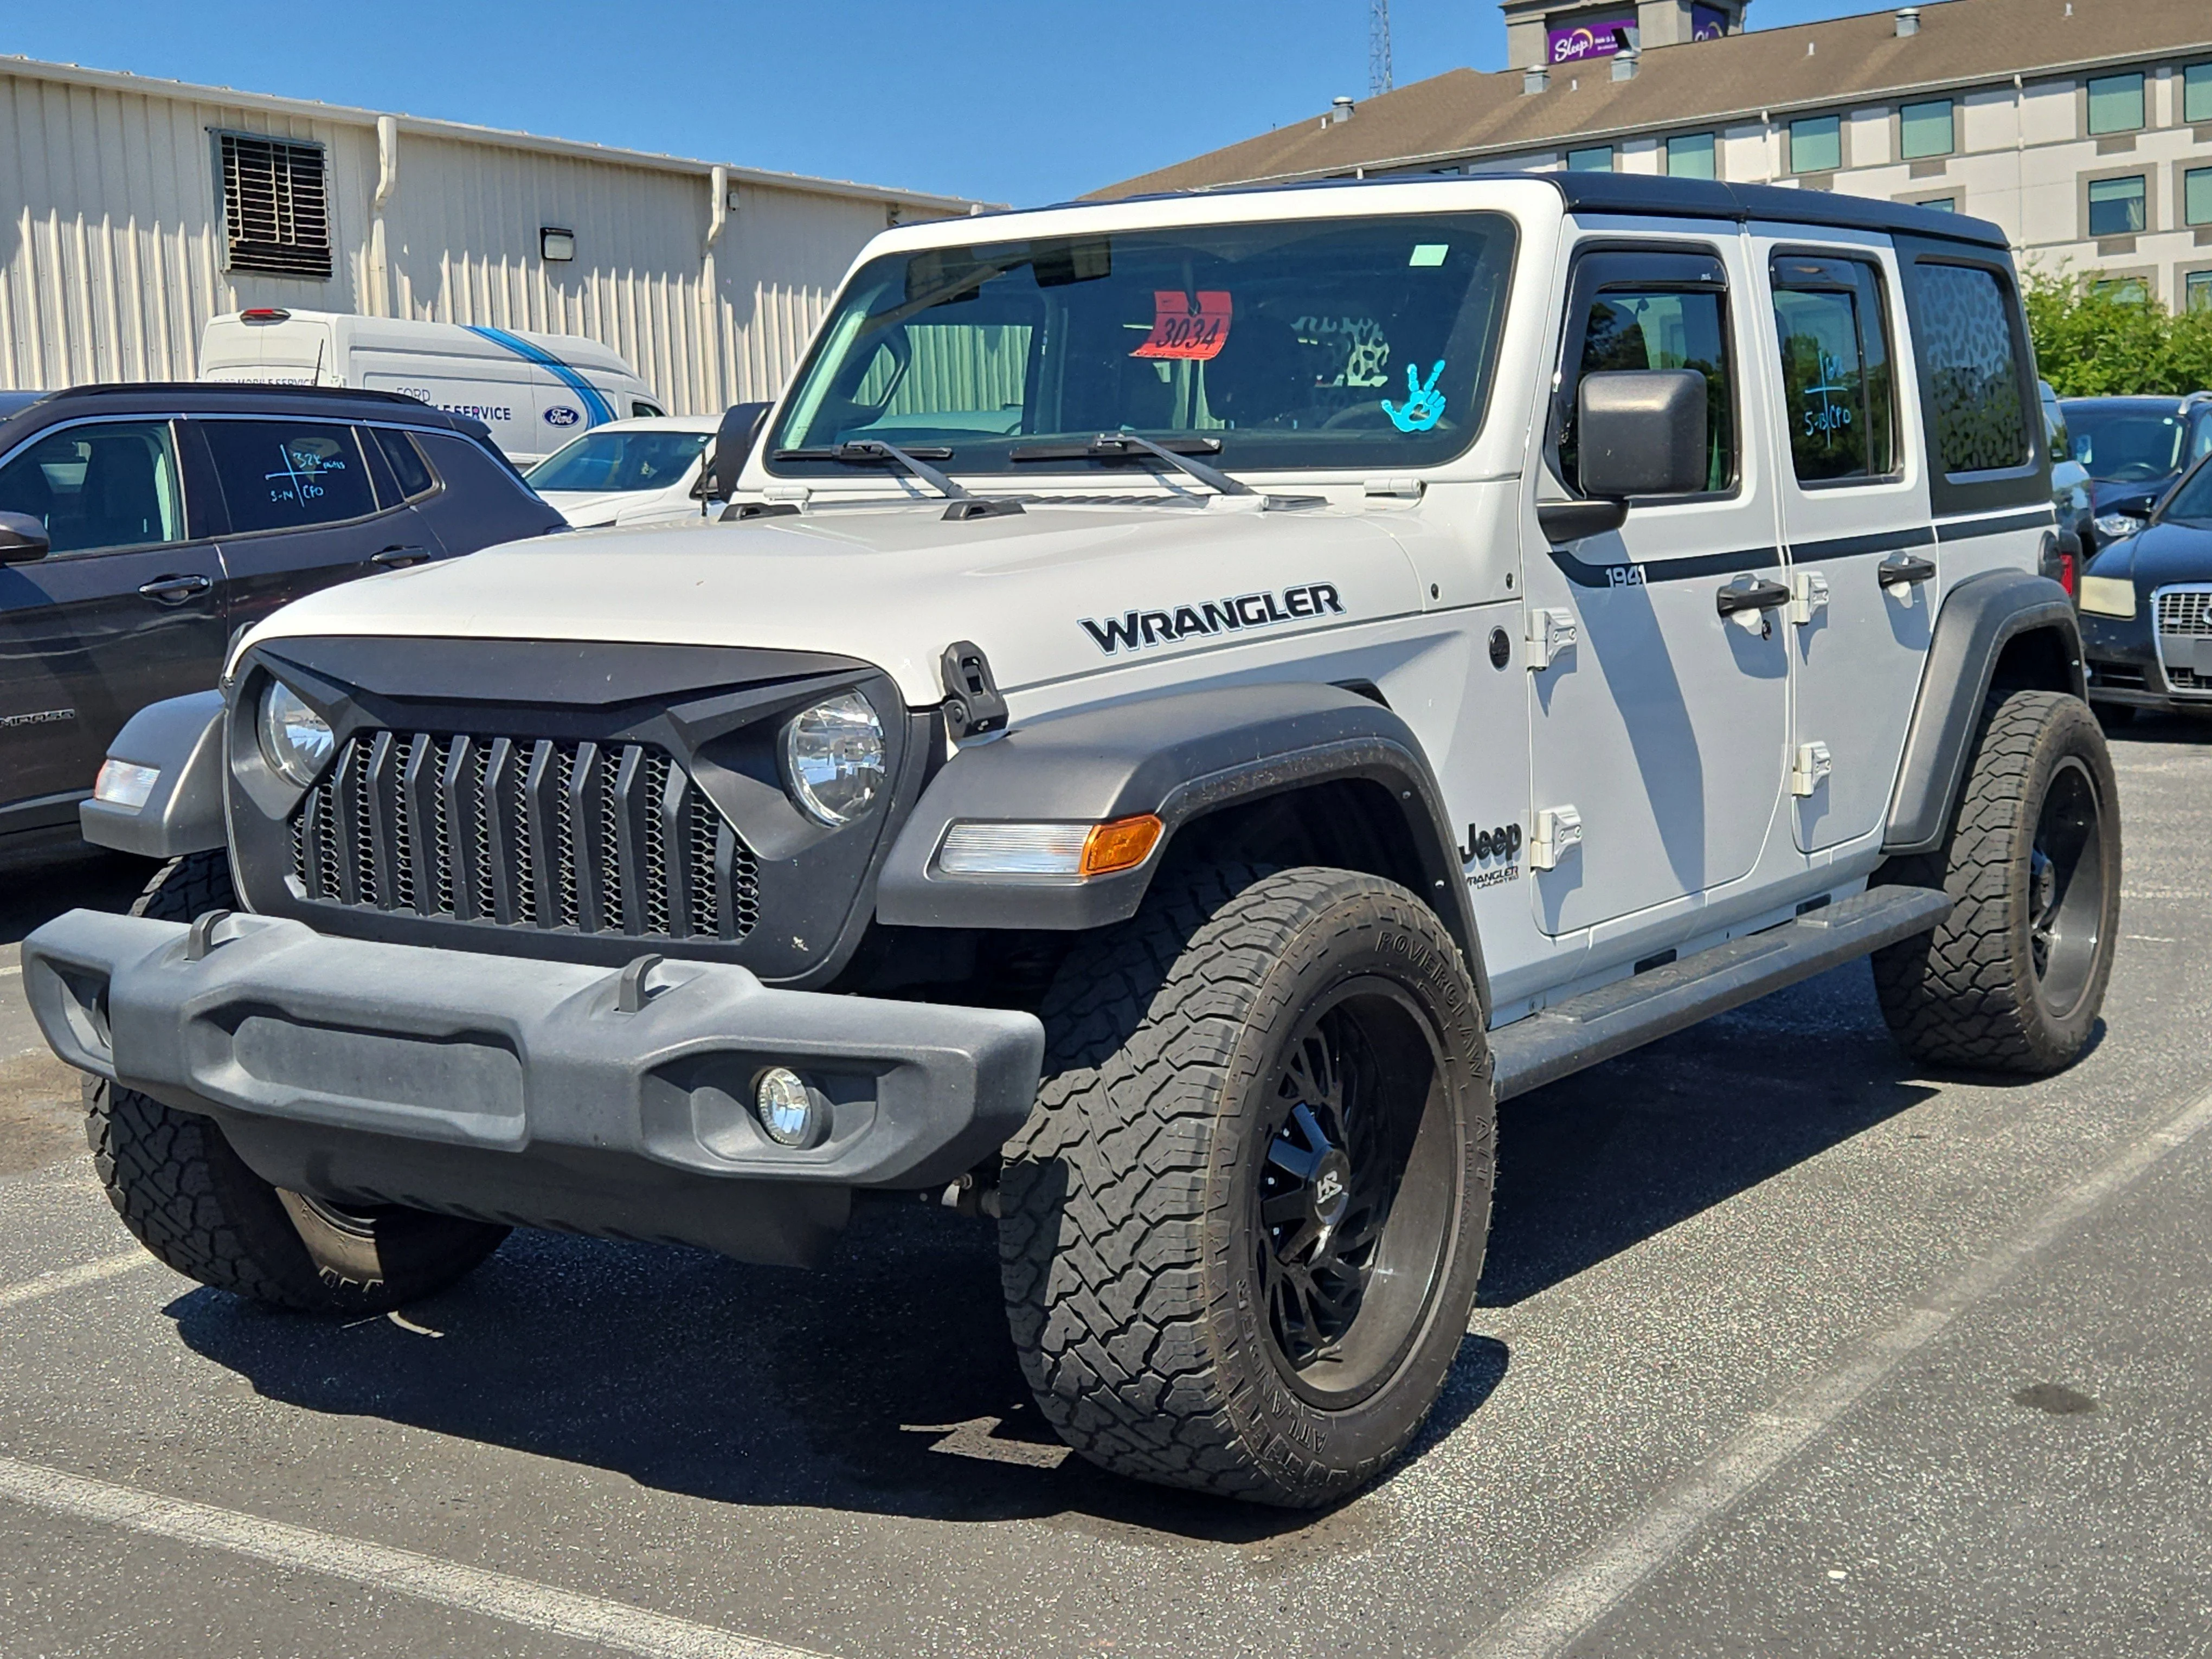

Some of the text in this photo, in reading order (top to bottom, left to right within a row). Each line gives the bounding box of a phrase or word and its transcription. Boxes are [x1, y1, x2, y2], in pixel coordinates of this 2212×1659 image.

[1554, 37, 1589, 62] Sleep
[1155, 317, 1221, 350] 3034
[454, 405, 511, 420] SERVICE
[1606, 564, 1647, 588] 1941
[1078, 582, 1346, 655] WRANGLER
[1458, 822, 1522, 864] Jeep
[1467, 866, 1519, 886] RANGLER
